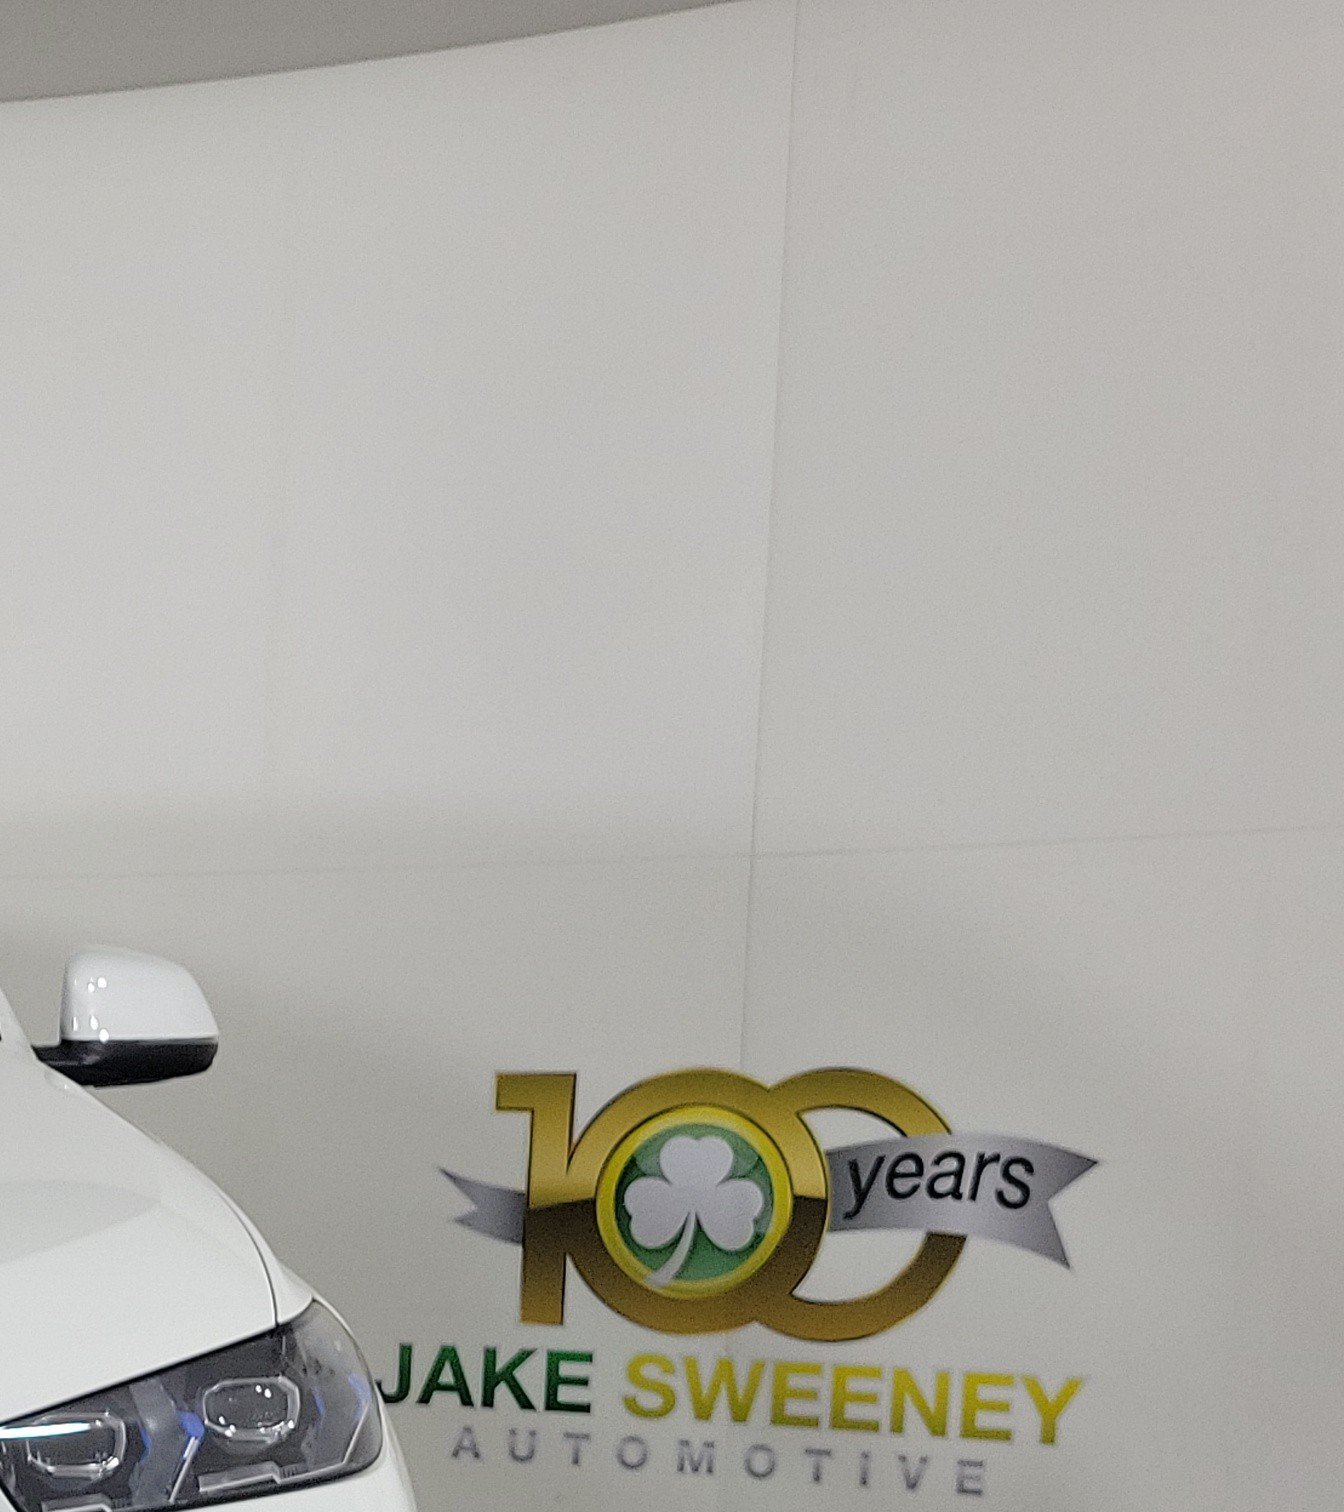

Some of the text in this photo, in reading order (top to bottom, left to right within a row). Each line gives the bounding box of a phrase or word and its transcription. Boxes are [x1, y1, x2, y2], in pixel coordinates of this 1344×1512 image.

[494, 1065, 1036, 1343] 100 years
[374, 1341, 1085, 1446] JAKE SWEENEY
[450, 1425, 987, 1497] AUTOMOTIVE
